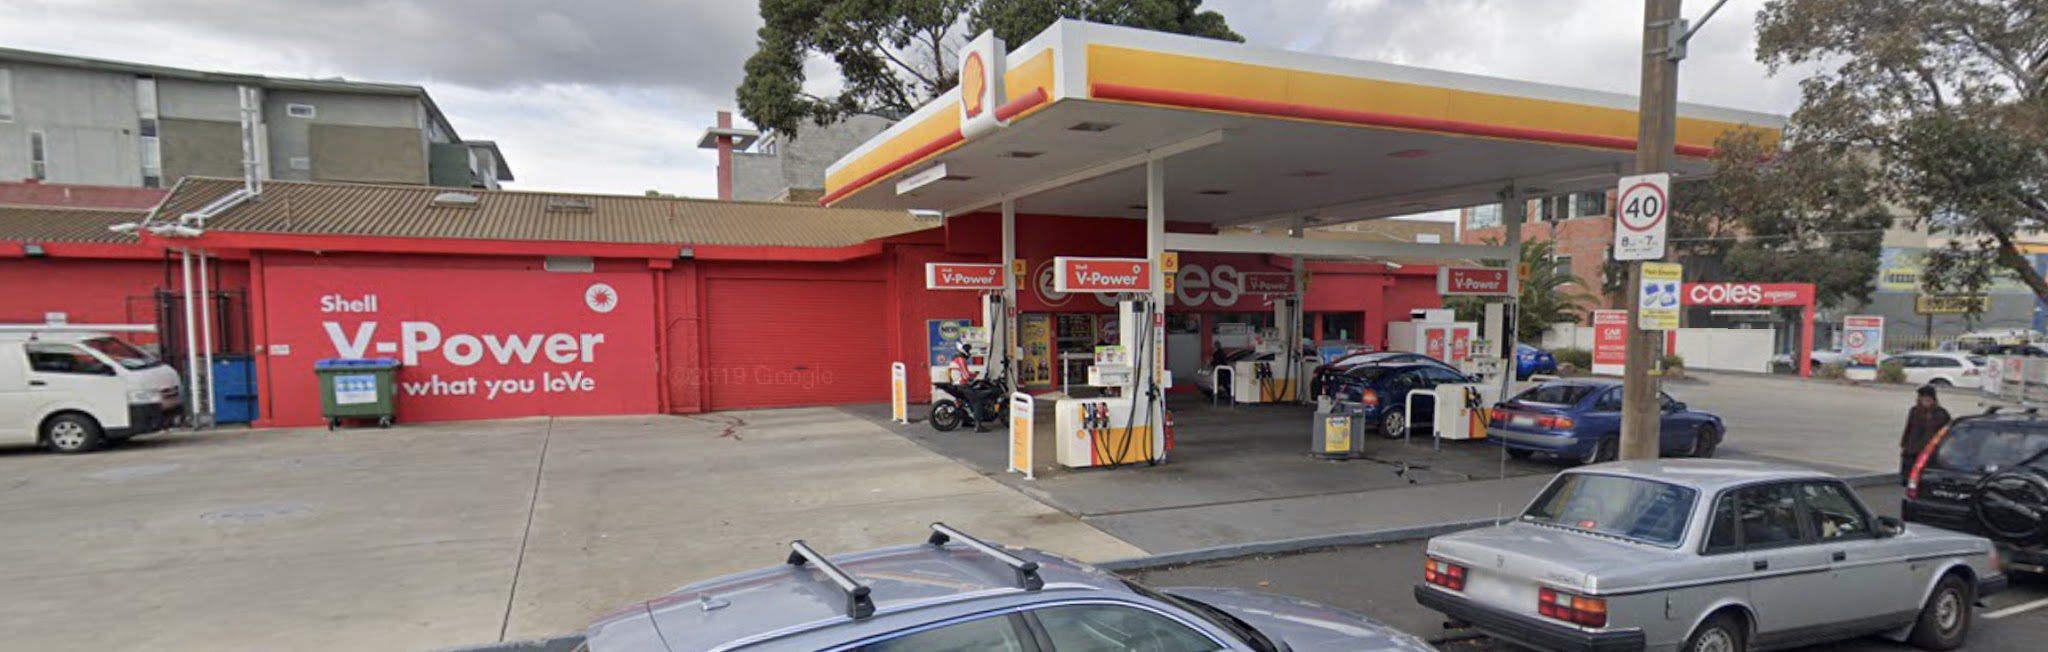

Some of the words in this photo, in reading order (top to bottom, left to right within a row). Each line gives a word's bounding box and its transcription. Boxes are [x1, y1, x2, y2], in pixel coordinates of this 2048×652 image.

[1625, 196, 1657, 218] 40
[1165, 257, 1173, 267] 6
[942, 273, 993, 284] V-Power
[1075, 271, 1138, 285] V-Power
[1455, 278, 1499, 289] V-Power
[1690, 282, 1762, 303] coles
[321, 294, 377, 313] Shell
[322, 321, 604, 366] V-Power
[403, 375, 477, 396] what
[484, 379, 535, 399] you
